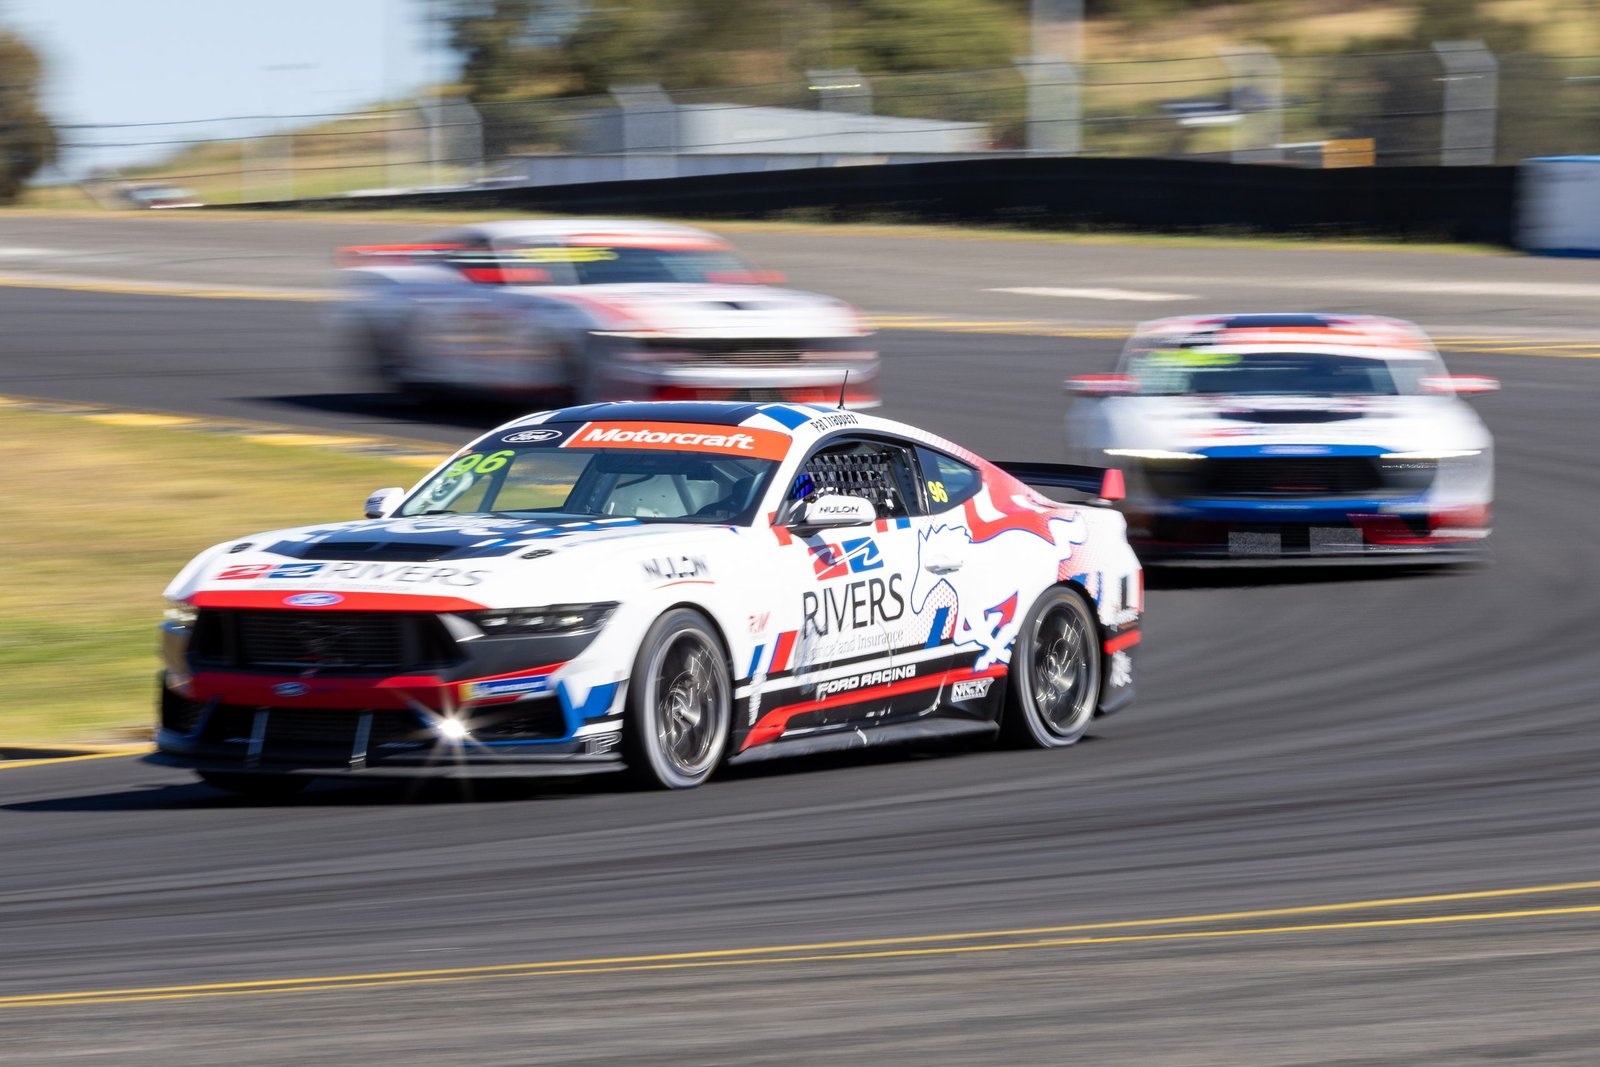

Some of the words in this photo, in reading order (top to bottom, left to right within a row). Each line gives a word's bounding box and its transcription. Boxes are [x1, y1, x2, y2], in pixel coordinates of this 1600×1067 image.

[810, 418, 829, 433] Pat
[822, 413, 859, 428] Trappett
[582, 428, 754, 450] Motorcraft
[444, 450, 516, 477] 96
[927, 480, 949, 503] 96
[818, 505, 860, 514] NULON
[325, 561, 493, 587] RIVERS
[802, 572, 905, 640] RIVERS
[857, 628, 904, 651] Insurance
[818, 674, 859, 695] FORD
[860, 663, 917, 688] RACING
